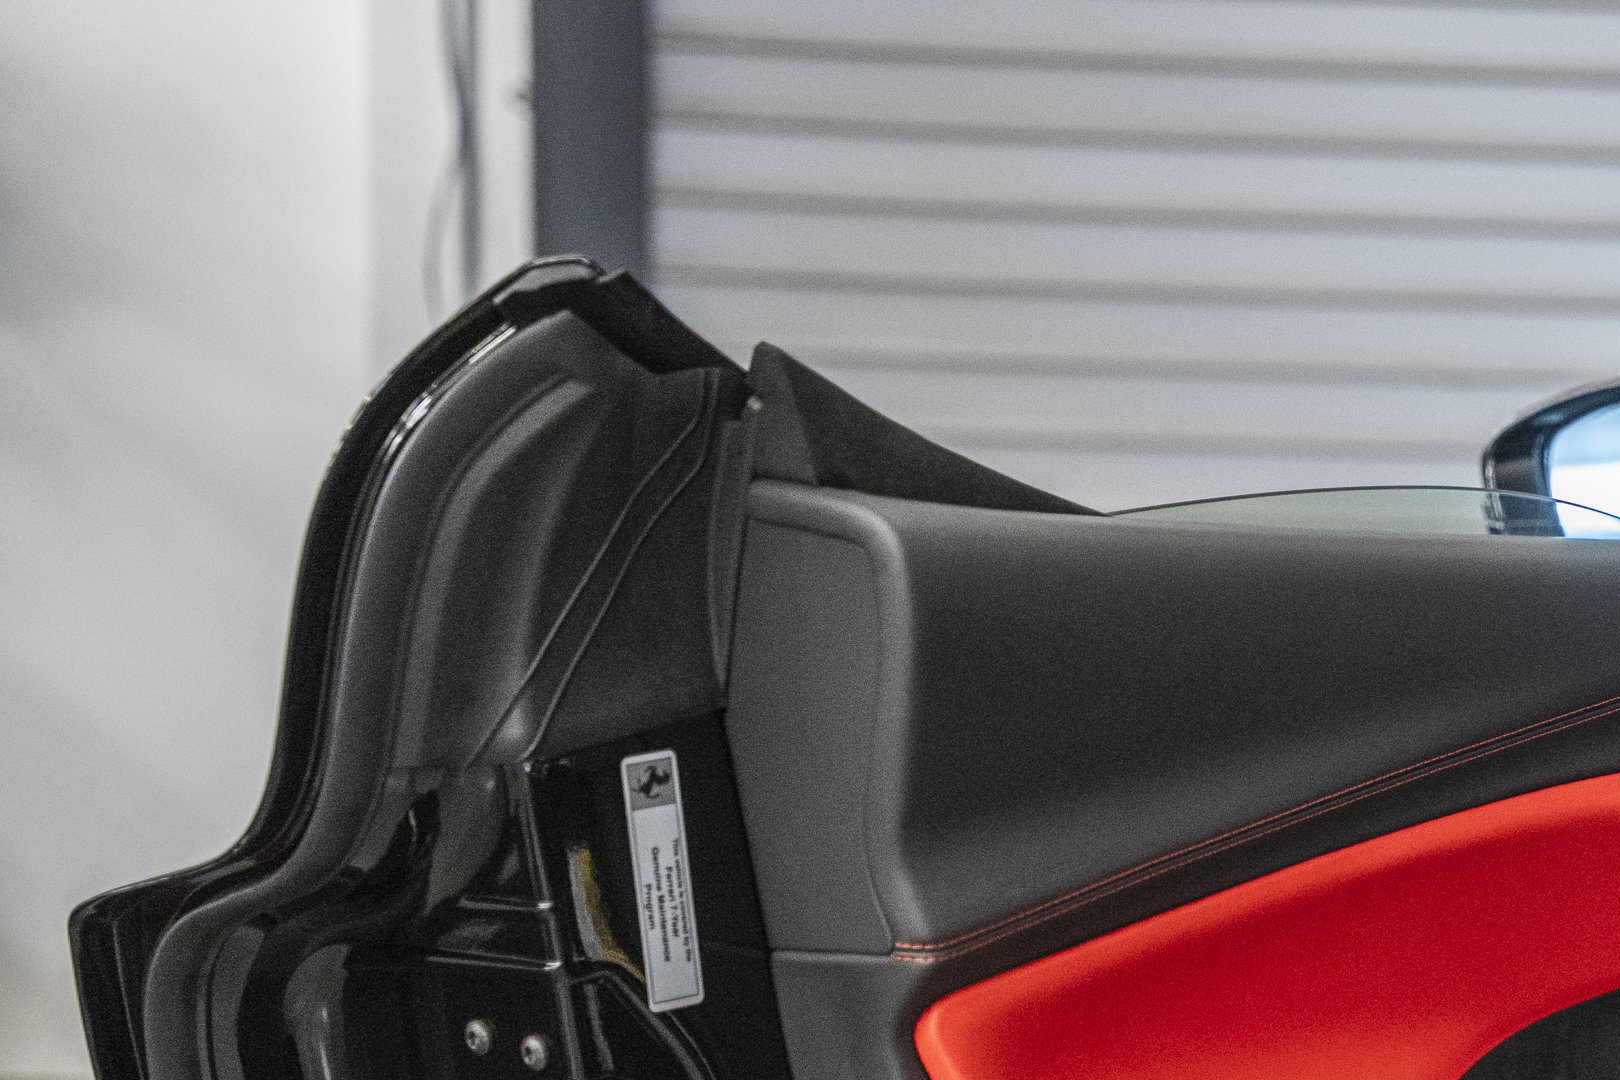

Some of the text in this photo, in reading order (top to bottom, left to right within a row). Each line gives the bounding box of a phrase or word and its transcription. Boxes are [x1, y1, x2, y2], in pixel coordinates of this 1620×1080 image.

[643, 882, 655, 931] Program
[651, 845, 670, 962] Genuine Maintenance
[666, 866, 675, 903] Ferrari
